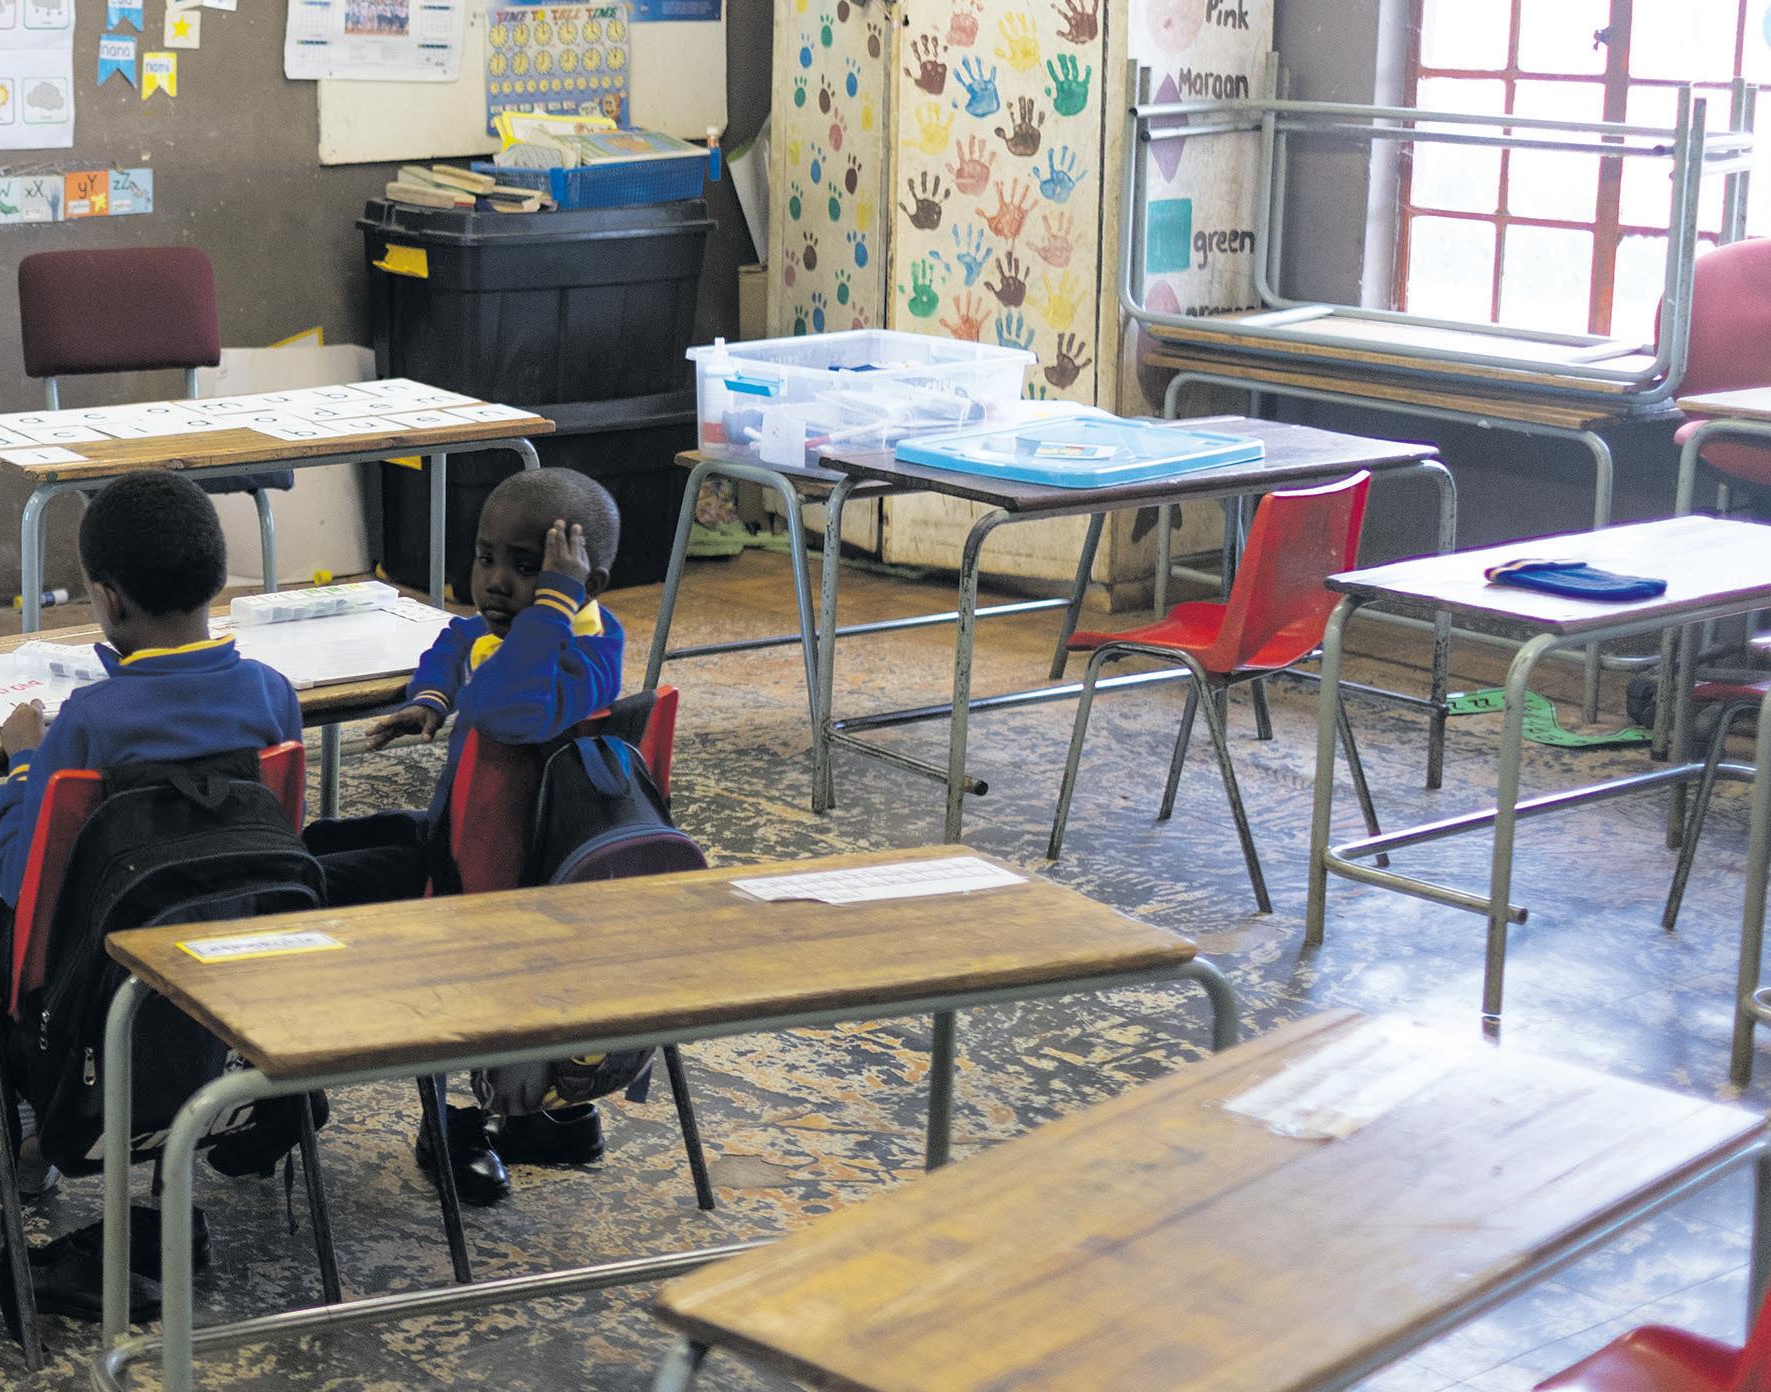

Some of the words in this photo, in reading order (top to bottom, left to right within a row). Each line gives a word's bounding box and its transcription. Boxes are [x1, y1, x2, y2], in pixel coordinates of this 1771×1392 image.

[496, 11, 527, 23] TIME
[550, 9, 581, 22] TELL
[586, 7, 617, 19] TIME
[24, 180, 44, 198] xX
[77, 174, 98, 200] yY
[113, 171, 131, 191] zZ
[1194, 230, 1255, 270] green
